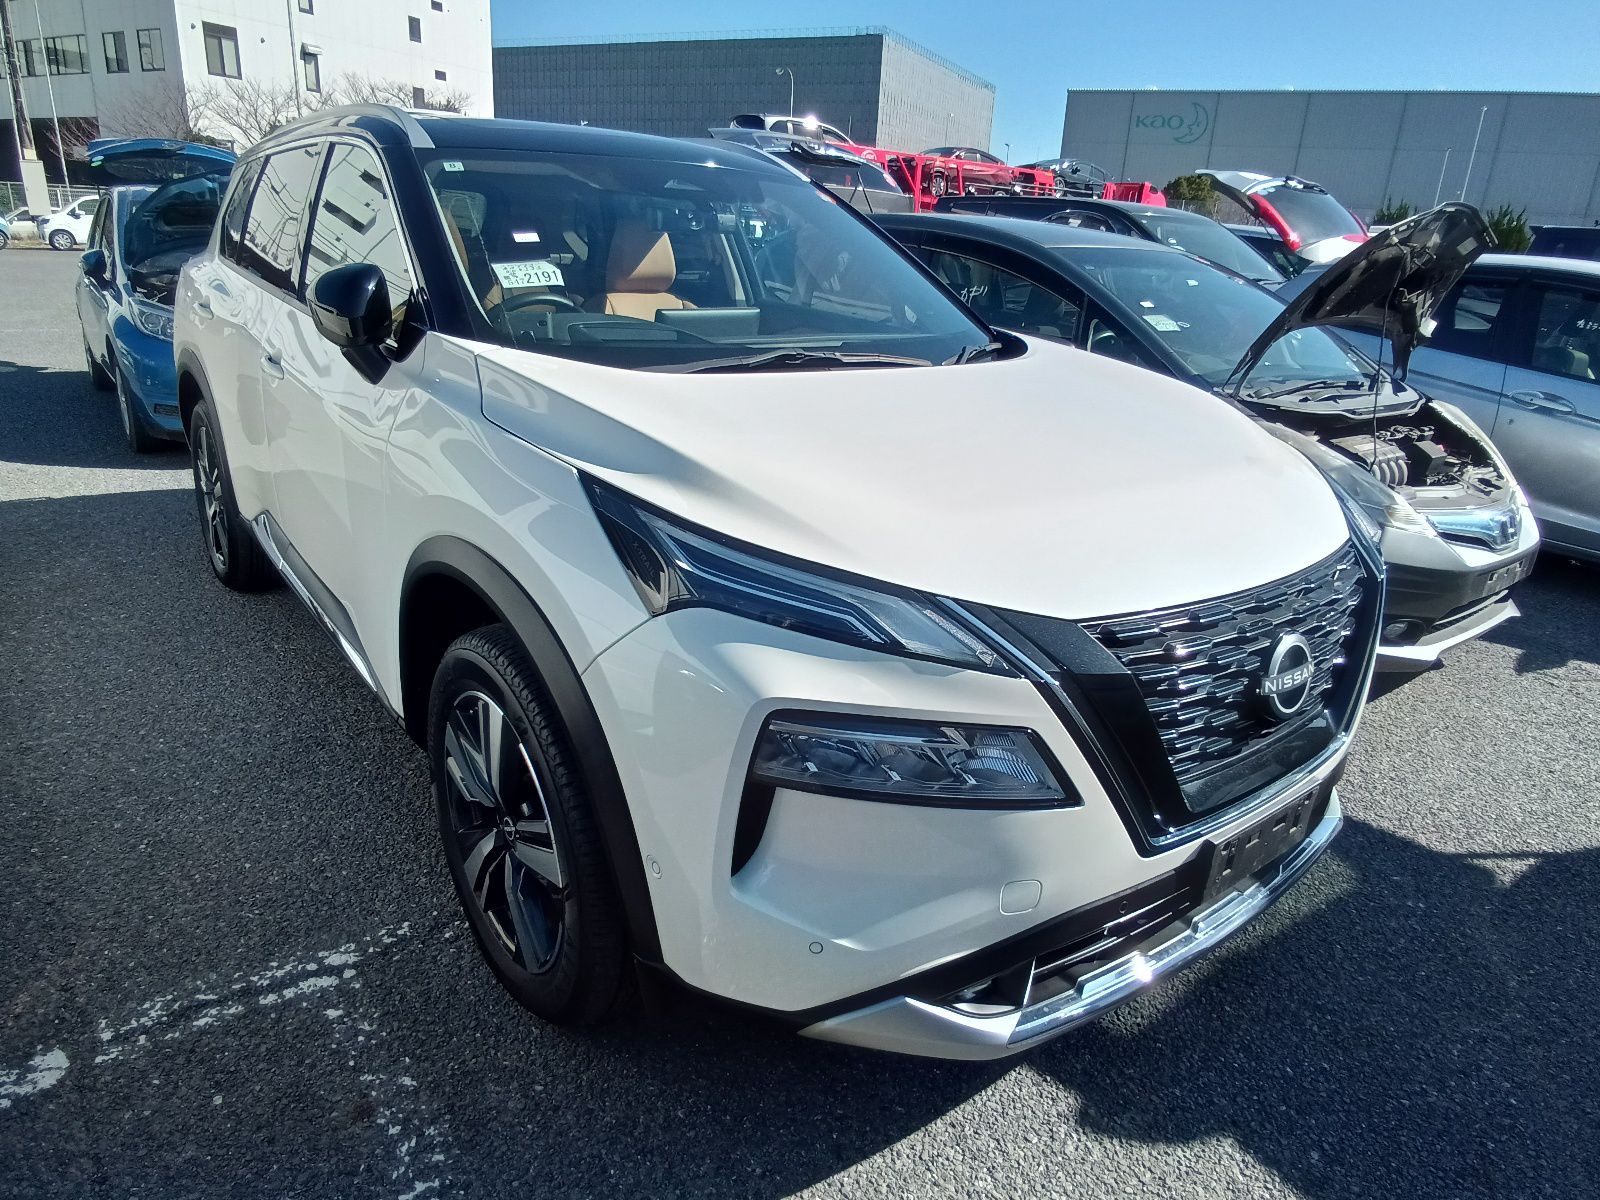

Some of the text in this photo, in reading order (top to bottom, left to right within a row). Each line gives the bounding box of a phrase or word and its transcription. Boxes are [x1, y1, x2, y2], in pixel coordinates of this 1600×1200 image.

[1136, 114, 1184, 129] kao
[523, 270, 560, 284] 2191
[1264, 663, 1315, 693] NISSAN
